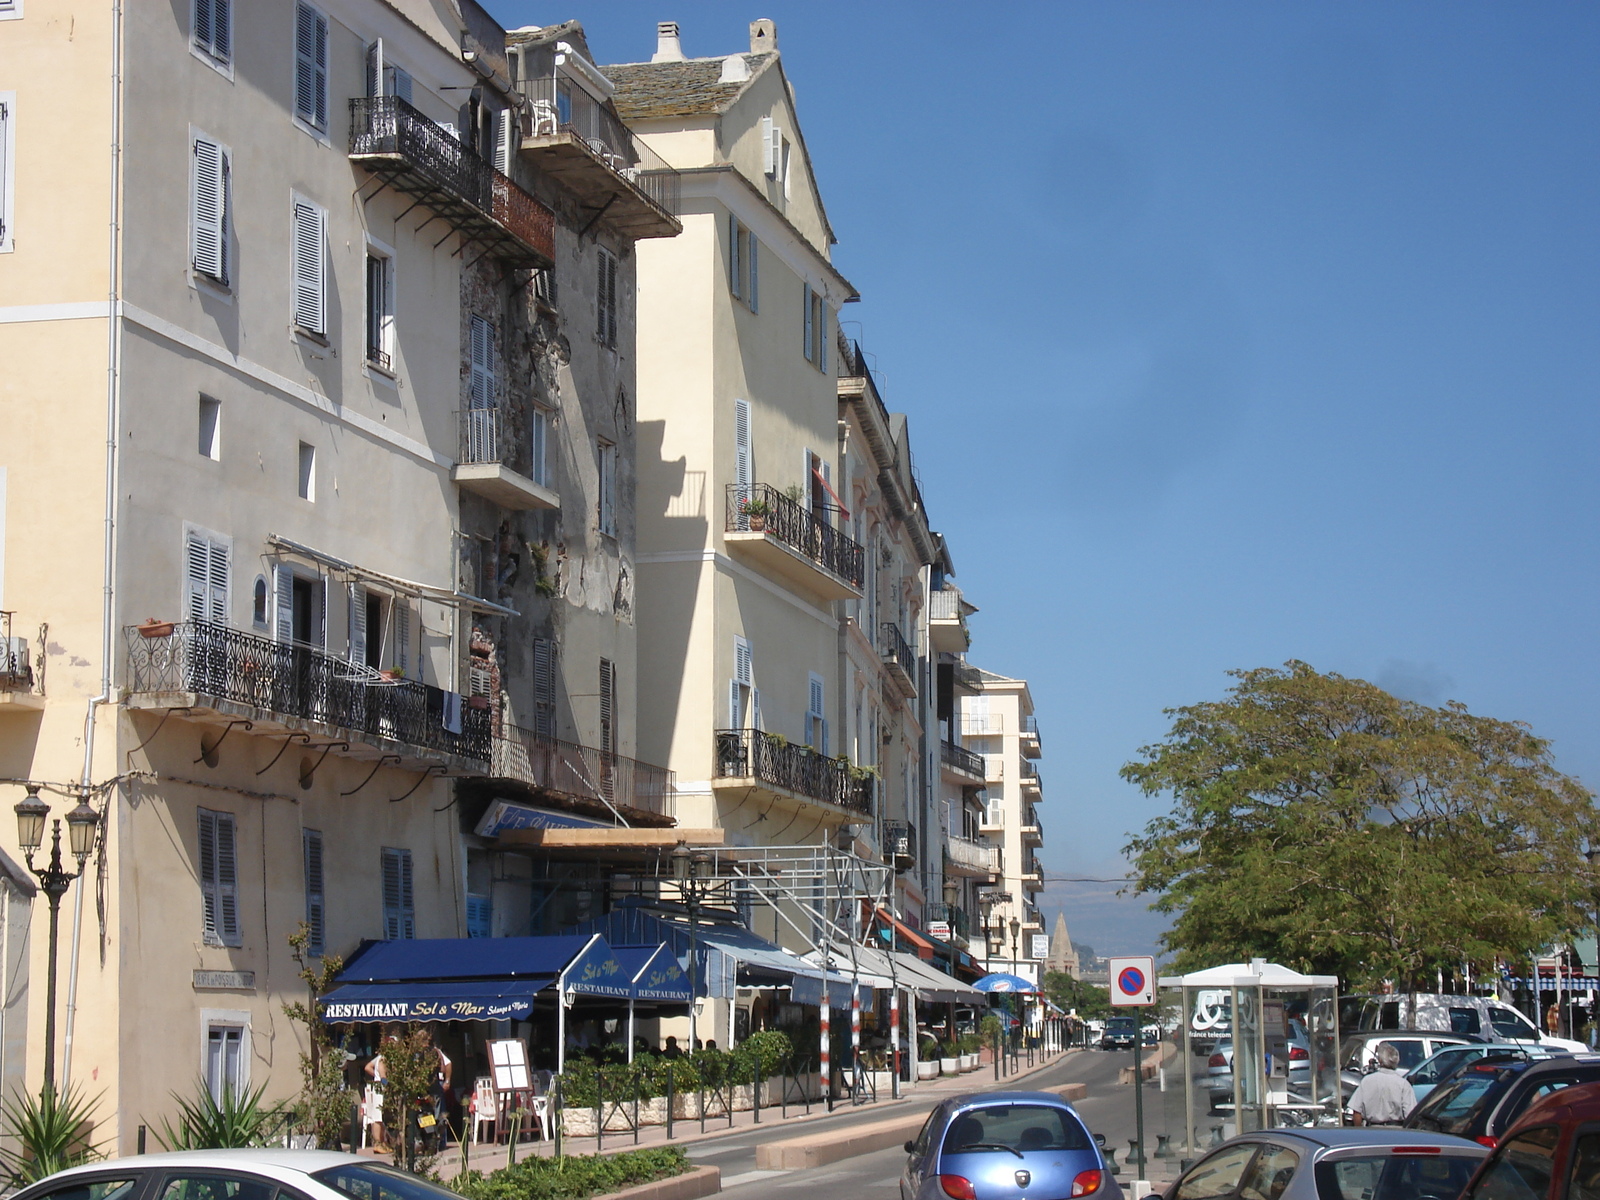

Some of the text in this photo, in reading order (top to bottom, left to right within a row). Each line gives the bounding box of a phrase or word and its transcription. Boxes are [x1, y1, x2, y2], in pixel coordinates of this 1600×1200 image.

[570, 982, 630, 996] RESTAURANT
[638, 989, 690, 1000] RESTAURANT
[326, 1003, 408, 1018] RESTAURANT
[410, 1002, 438, 1015] Sol
[439, 1004, 448, 1015] &
[451, 1002, 485, 1015] Mar
